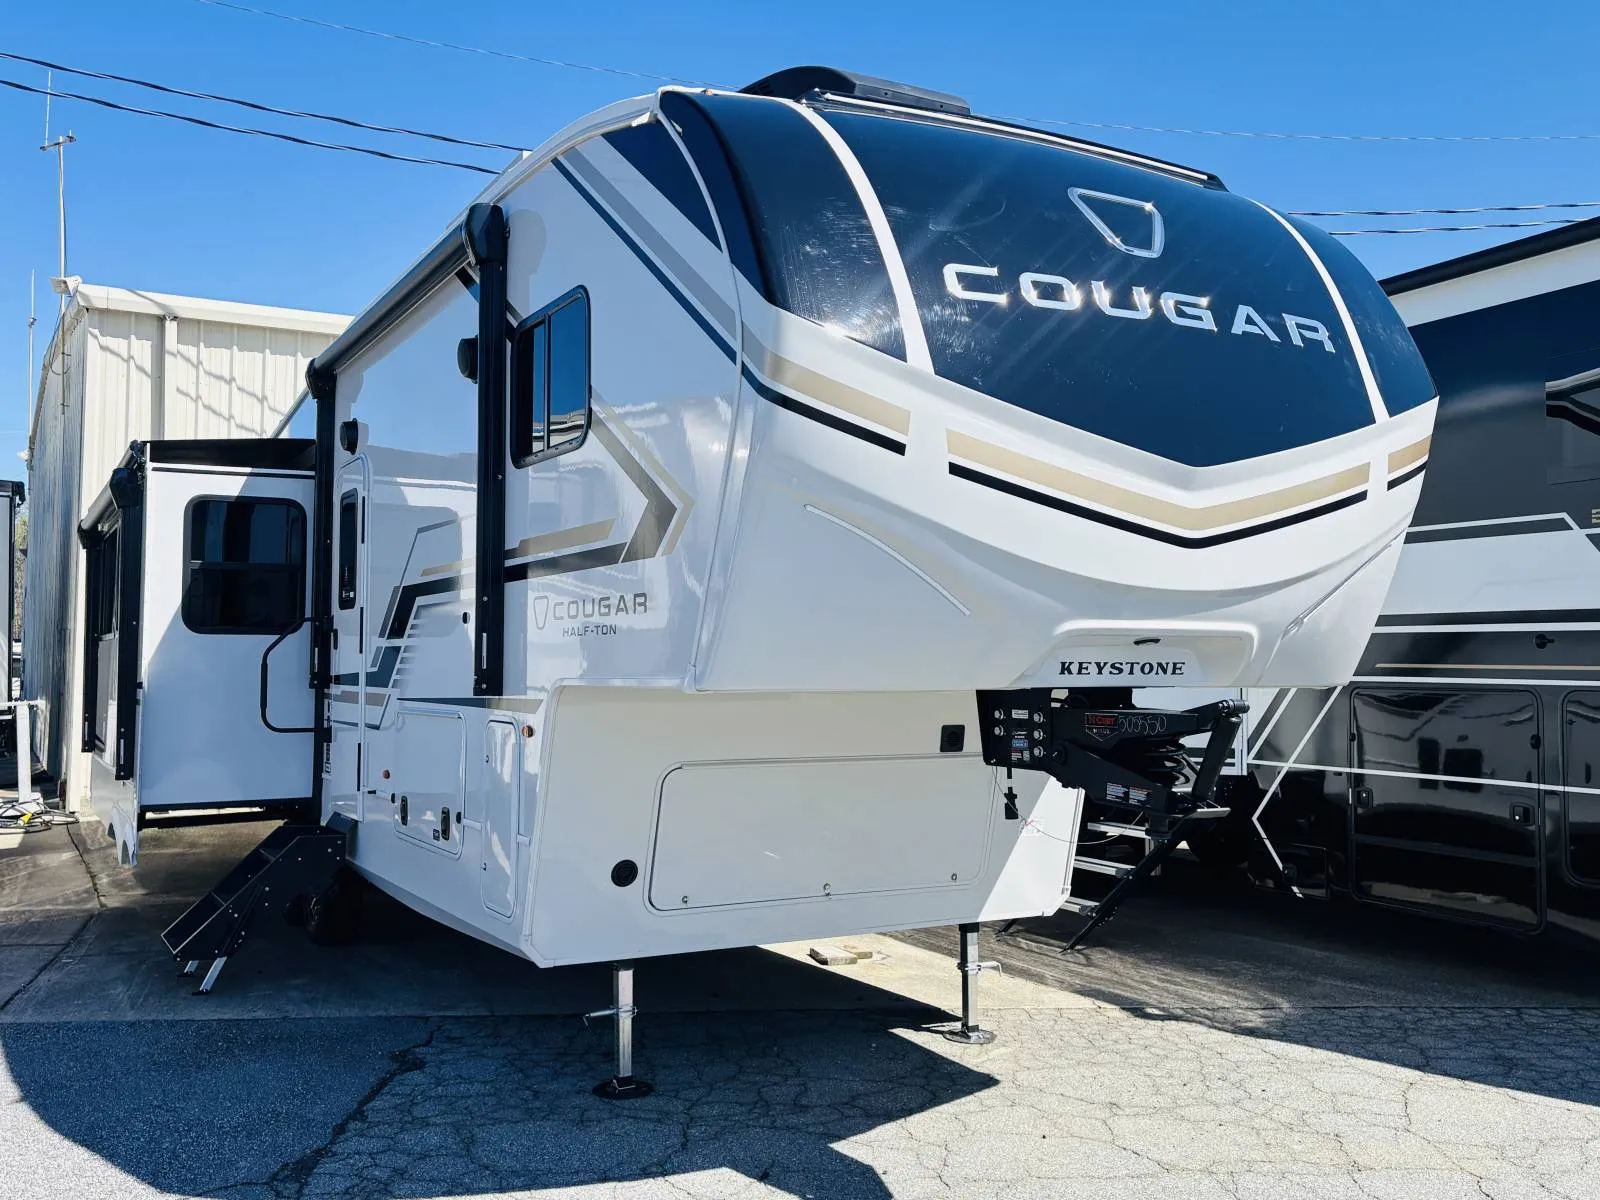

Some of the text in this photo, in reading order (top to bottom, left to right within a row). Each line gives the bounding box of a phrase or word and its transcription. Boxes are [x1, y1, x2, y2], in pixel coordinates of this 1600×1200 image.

[942, 262, 1336, 354] COUGAR
[552, 592, 648, 621] COUGAR
[562, 624, 617, 638] HALF-TON
[1058, 661, 1186, 676] KEYSTONE
